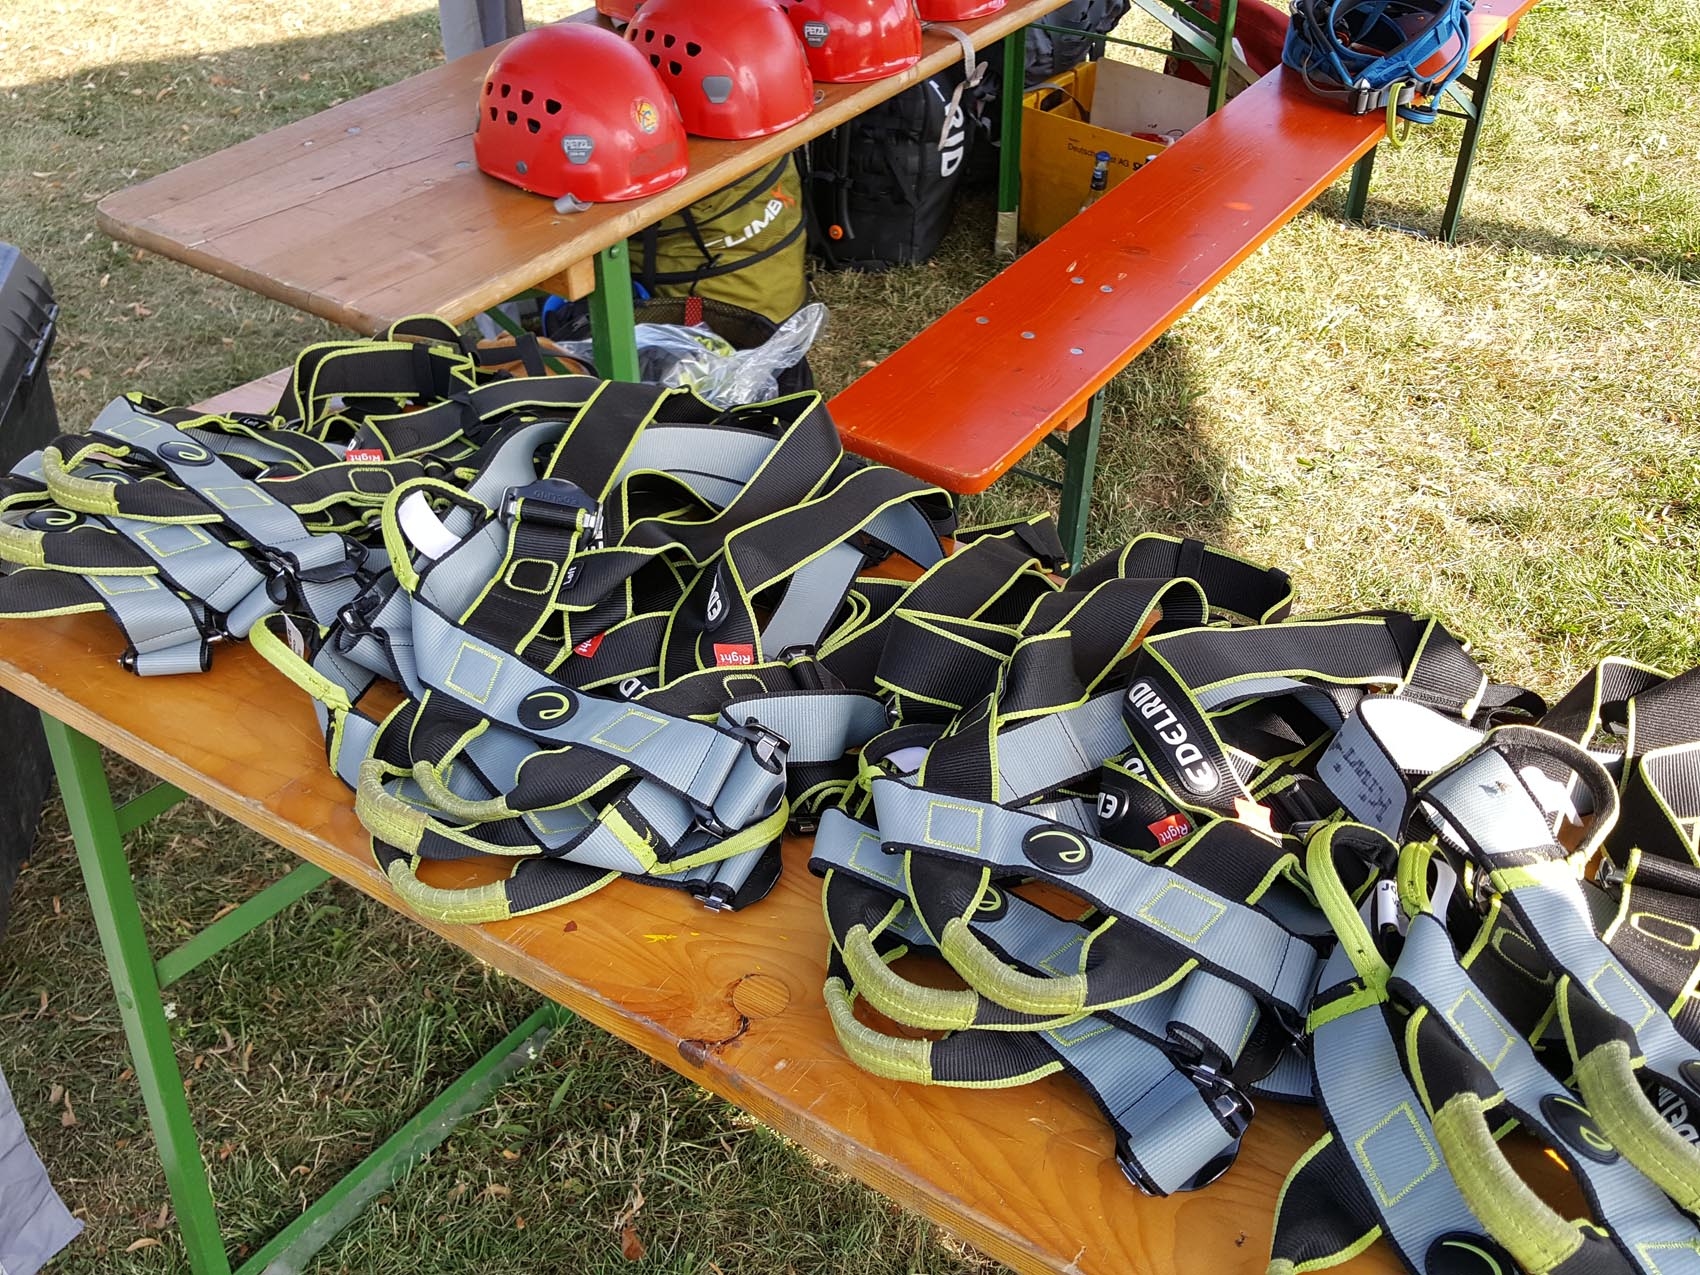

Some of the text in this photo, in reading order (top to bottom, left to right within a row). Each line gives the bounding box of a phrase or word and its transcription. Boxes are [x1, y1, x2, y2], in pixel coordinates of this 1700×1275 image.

[805, 25, 828, 38] PETZL
[720, 651, 751, 665] Right
[1128, 682, 1220, 793] EDELRID
[1159, 823, 1189, 844] Right
